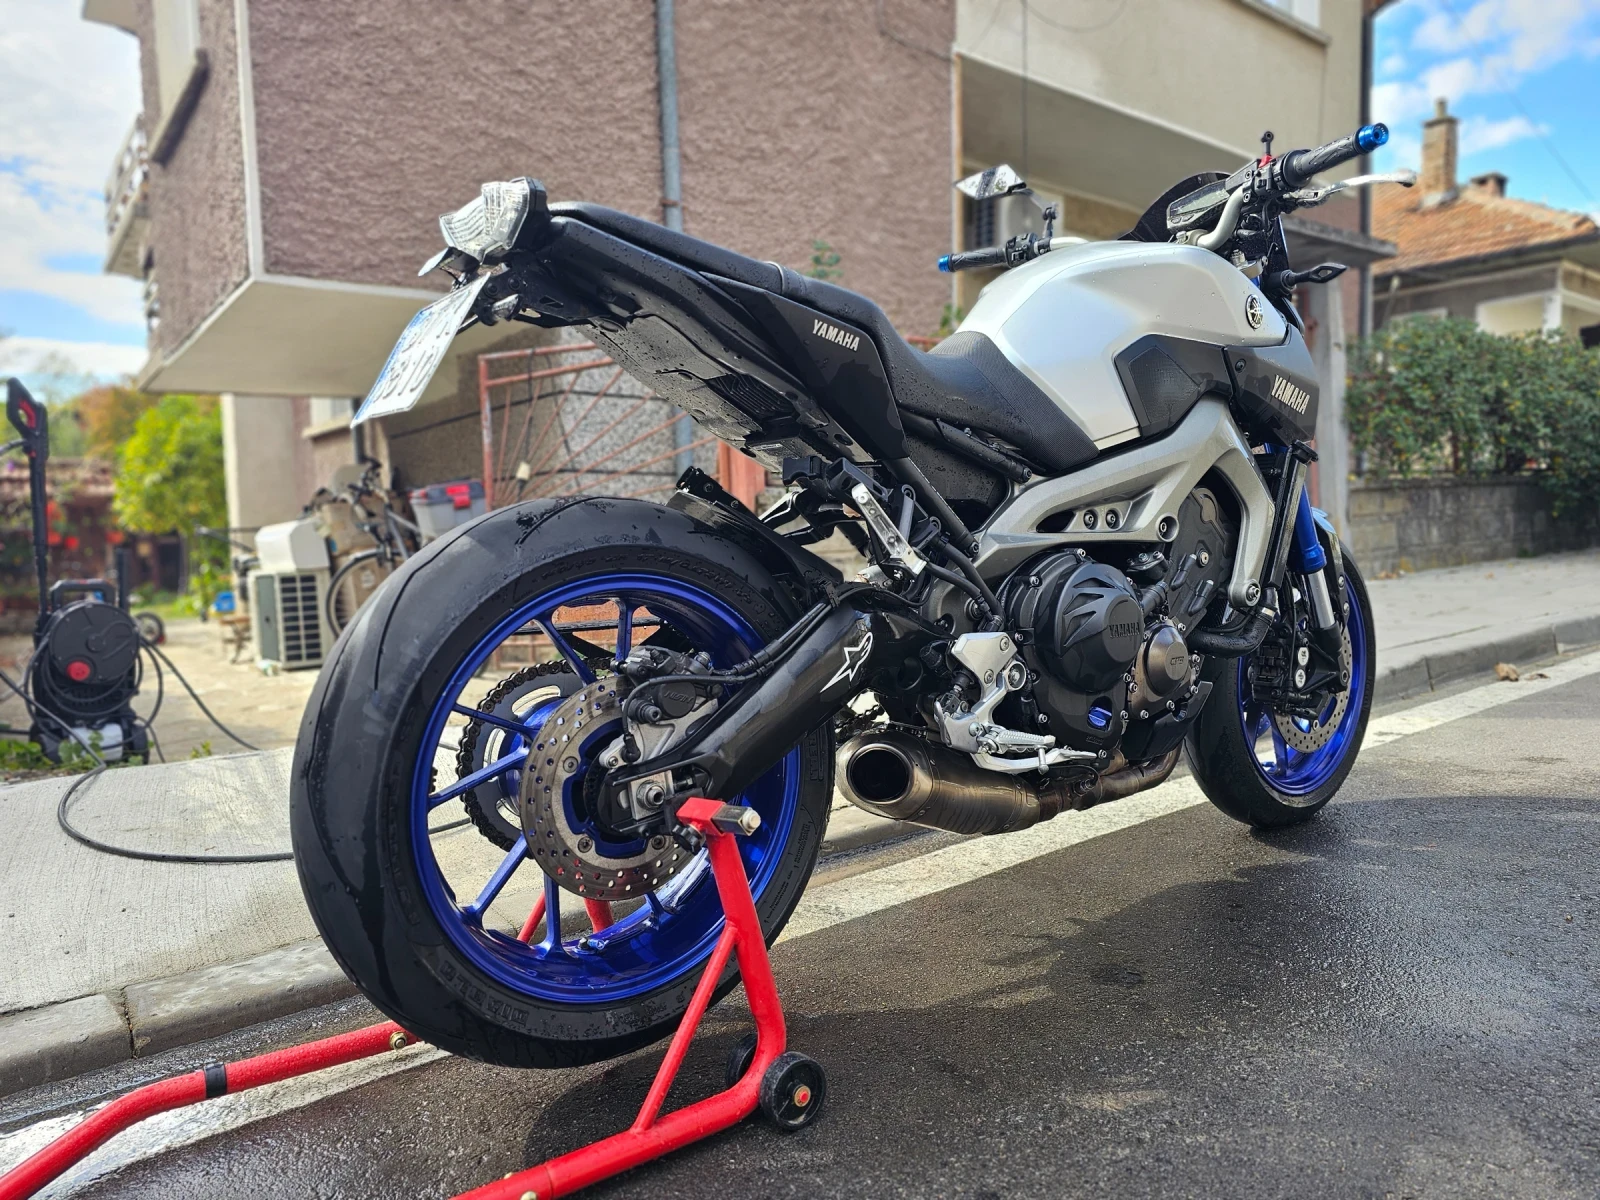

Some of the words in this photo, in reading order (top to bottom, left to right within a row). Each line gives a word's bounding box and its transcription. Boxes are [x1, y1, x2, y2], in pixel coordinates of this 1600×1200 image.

[812, 319, 860, 352] YAMAHA
[1271, 374, 1311, 415] YAMAHA
[1108, 621, 1141, 638] YAMAHA
